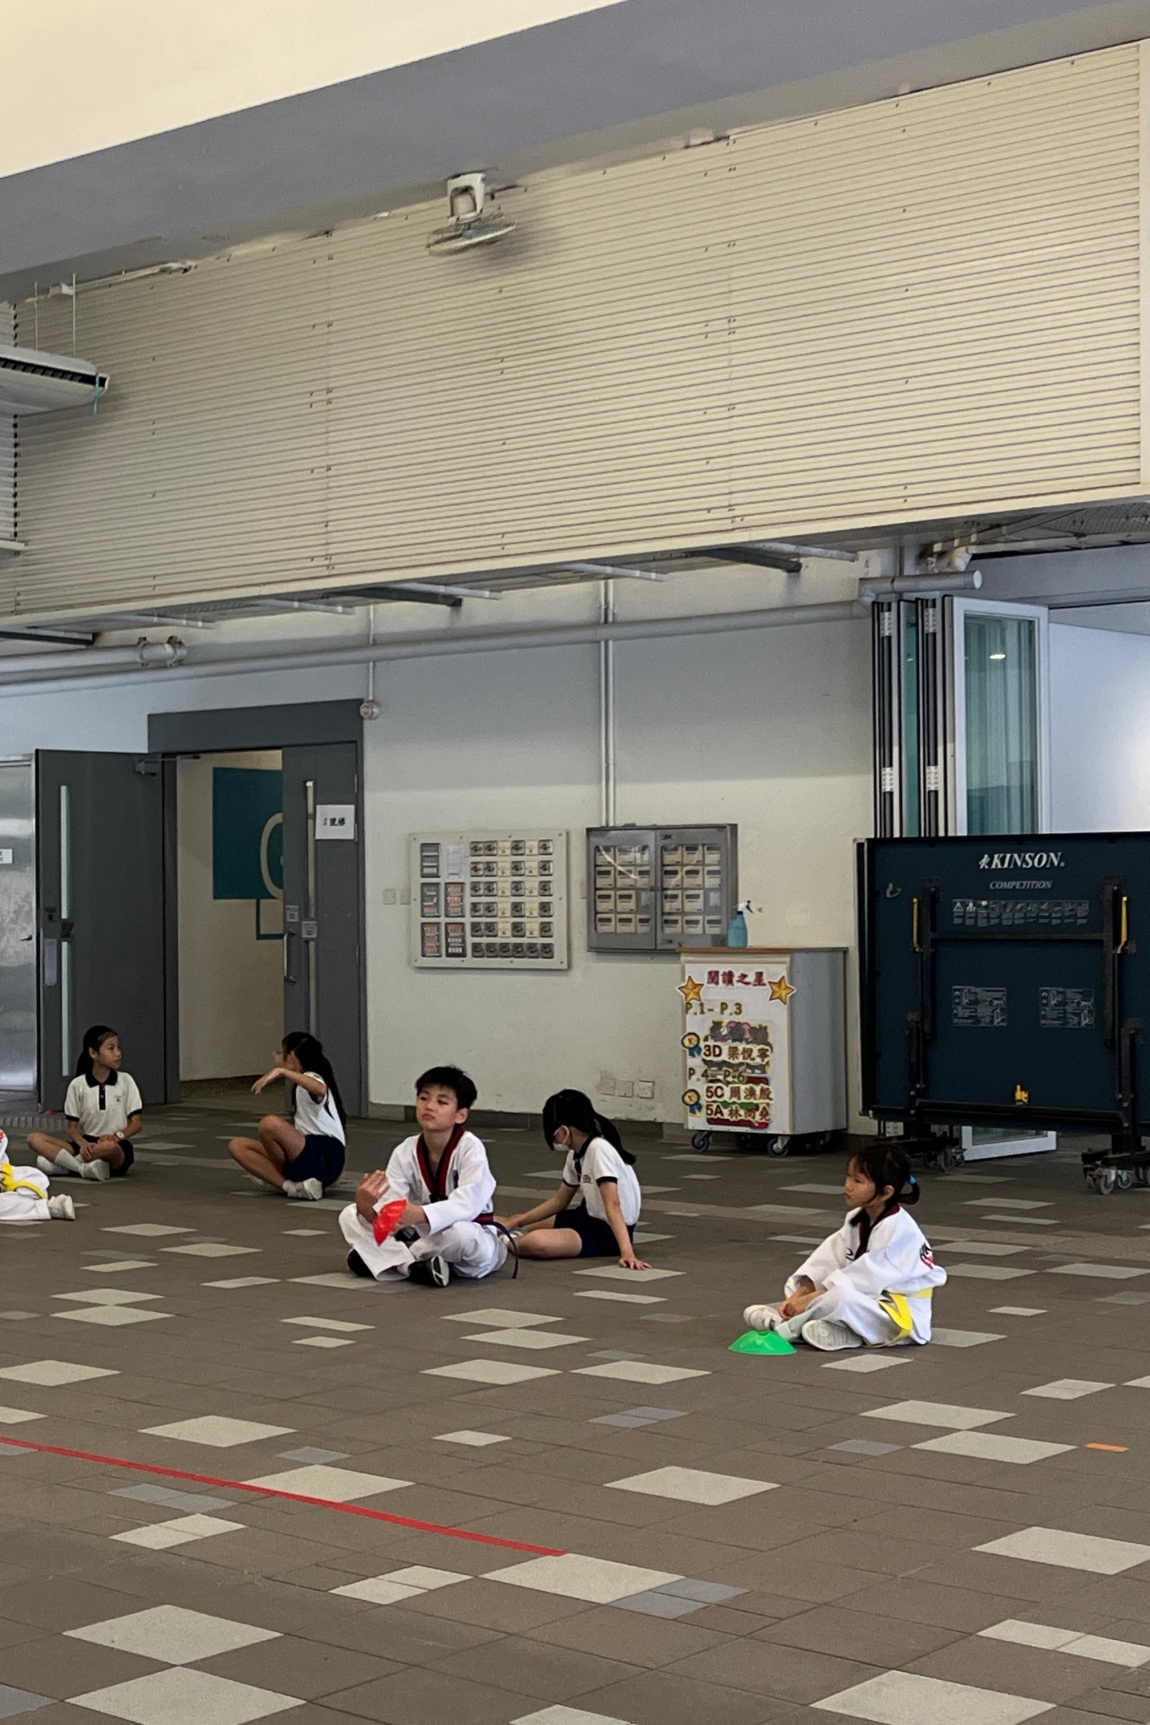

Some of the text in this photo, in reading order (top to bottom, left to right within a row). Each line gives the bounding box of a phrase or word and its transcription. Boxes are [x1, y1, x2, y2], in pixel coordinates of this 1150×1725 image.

[989, 880, 1053, 890] COMPETITION
[707, 970, 767, 986] 閱讀之星
[720, 1002, 743, 1015] P.3
[703, 1045, 722, 1058] 3D
[706, 1086, 724, 1099] 5C
[706, 1104, 724, 1117] 5A
